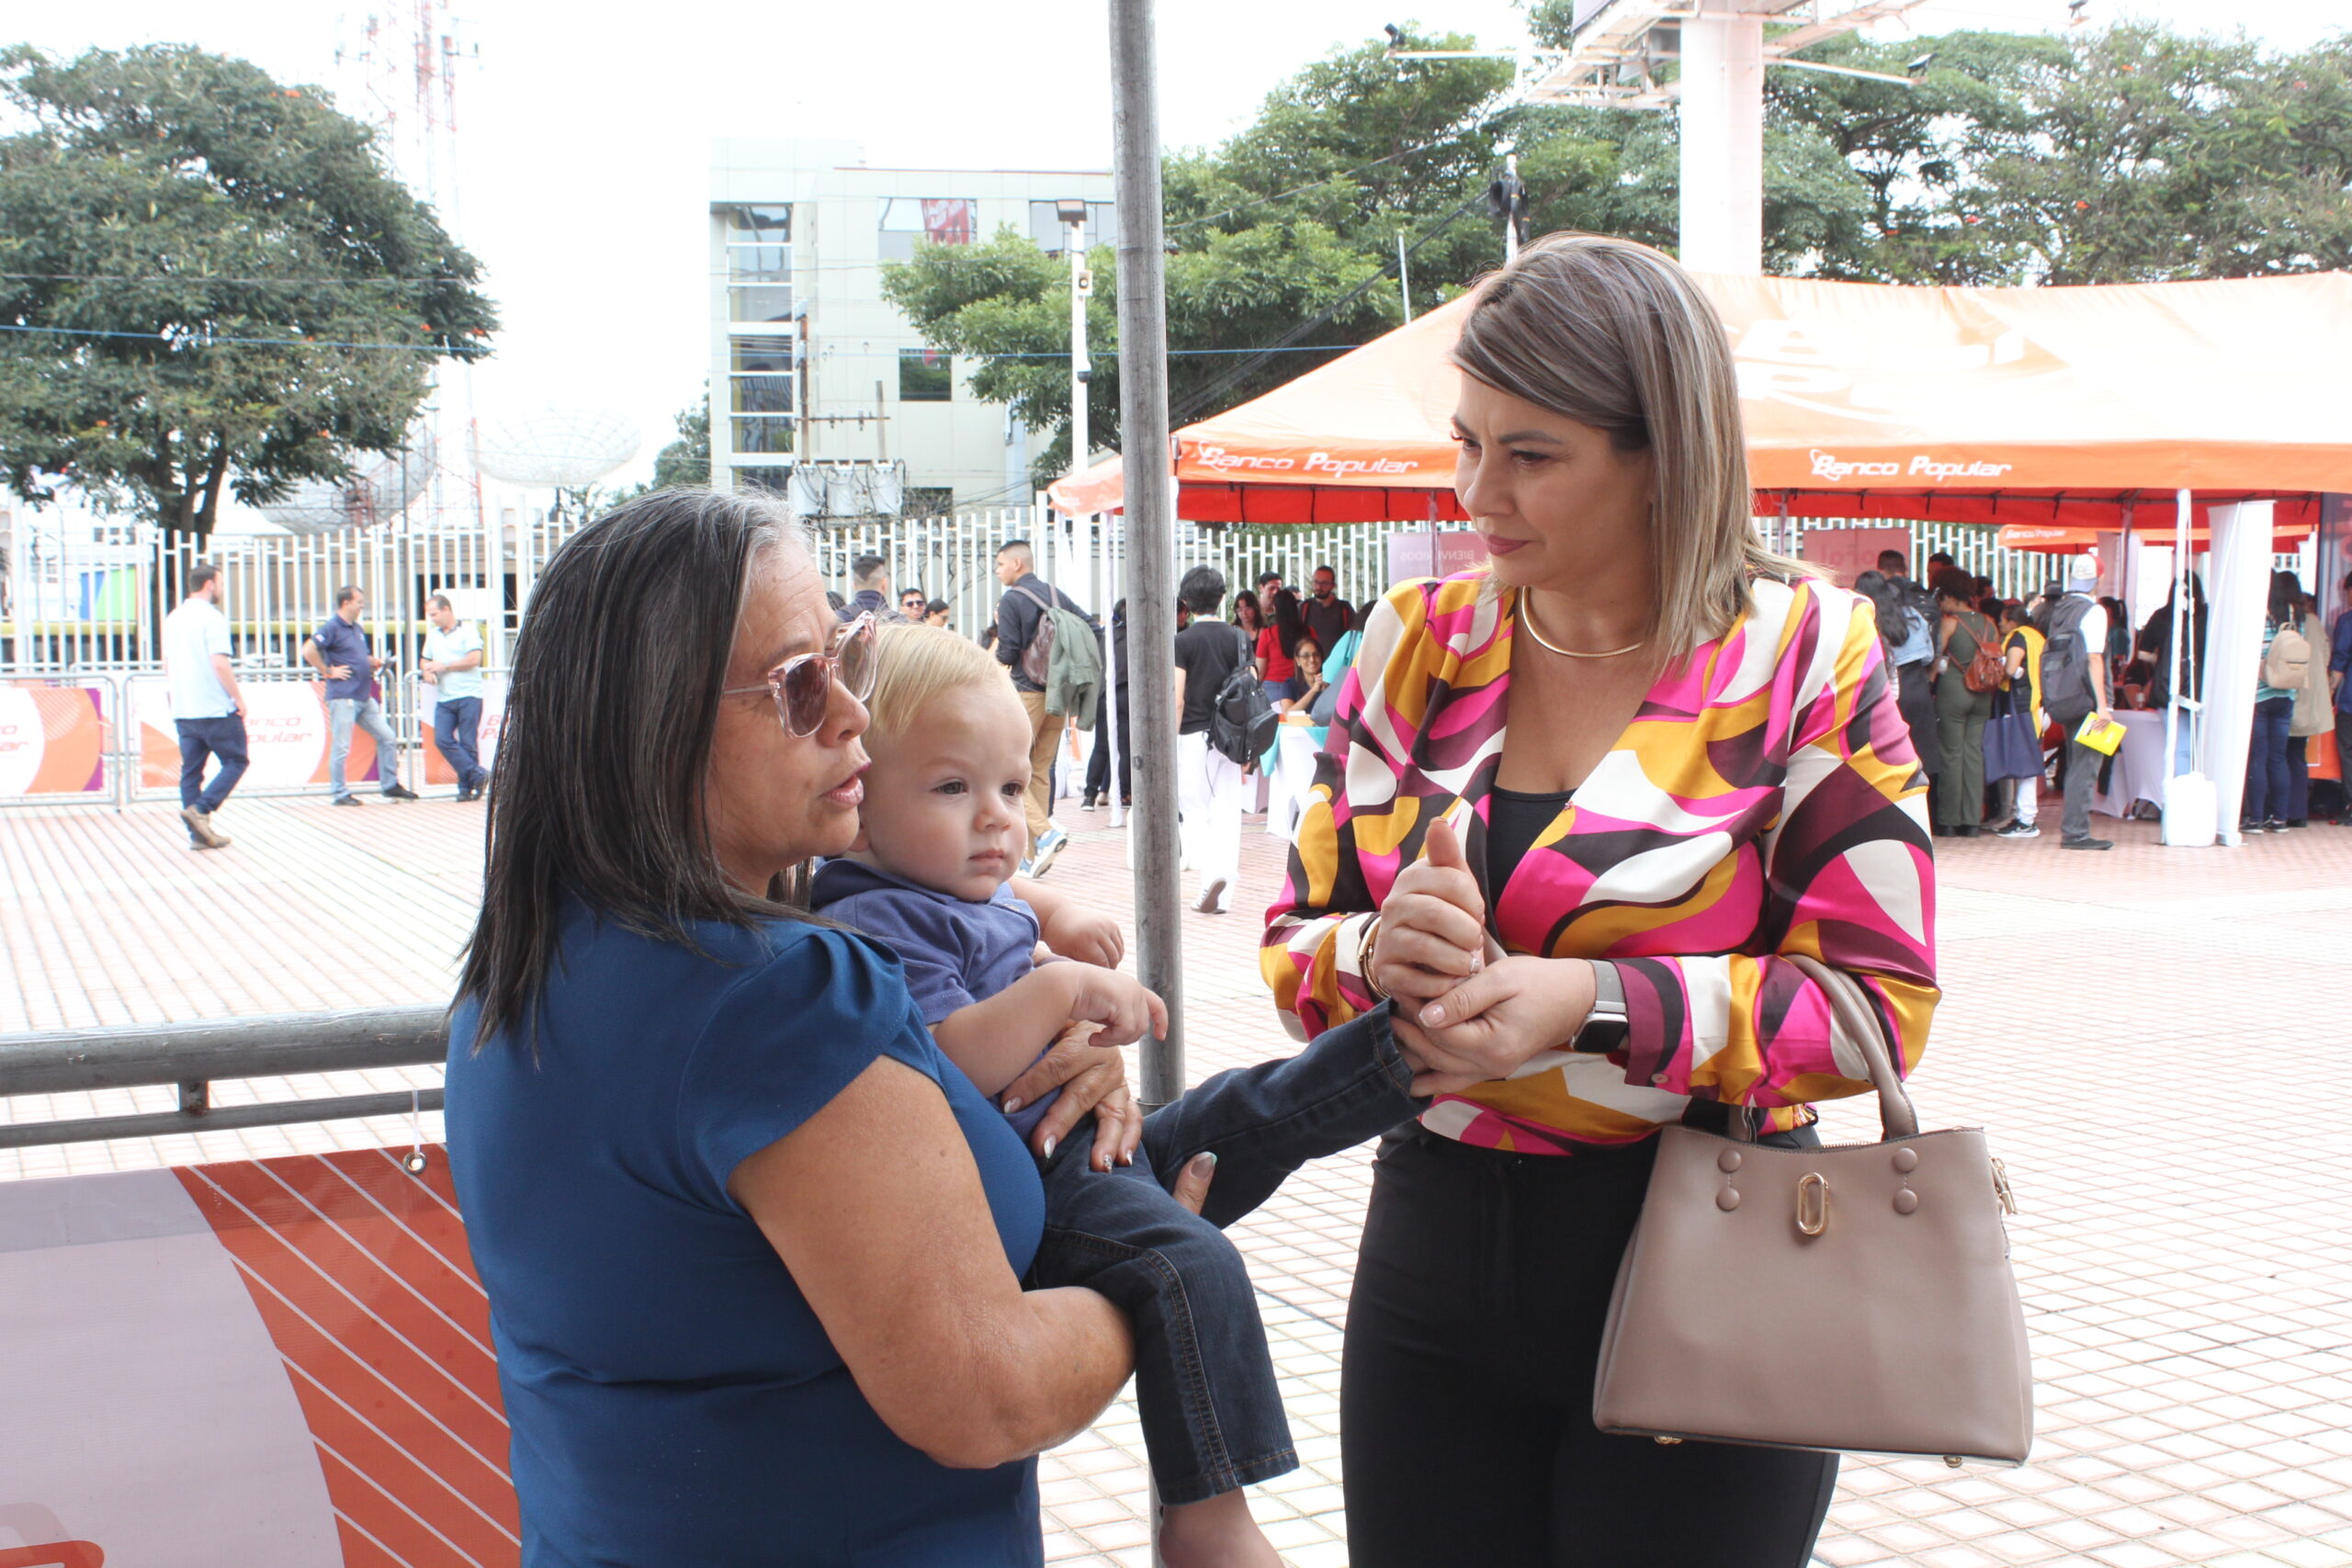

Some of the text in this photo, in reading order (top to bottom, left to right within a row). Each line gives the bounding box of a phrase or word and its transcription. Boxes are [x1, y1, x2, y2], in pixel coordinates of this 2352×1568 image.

[1197, 444, 1419, 478] Banco Popular
[1811, 454, 2013, 481] Banco Popular
[246, 716, 301, 728] anco
[247, 730, 312, 743] pular
